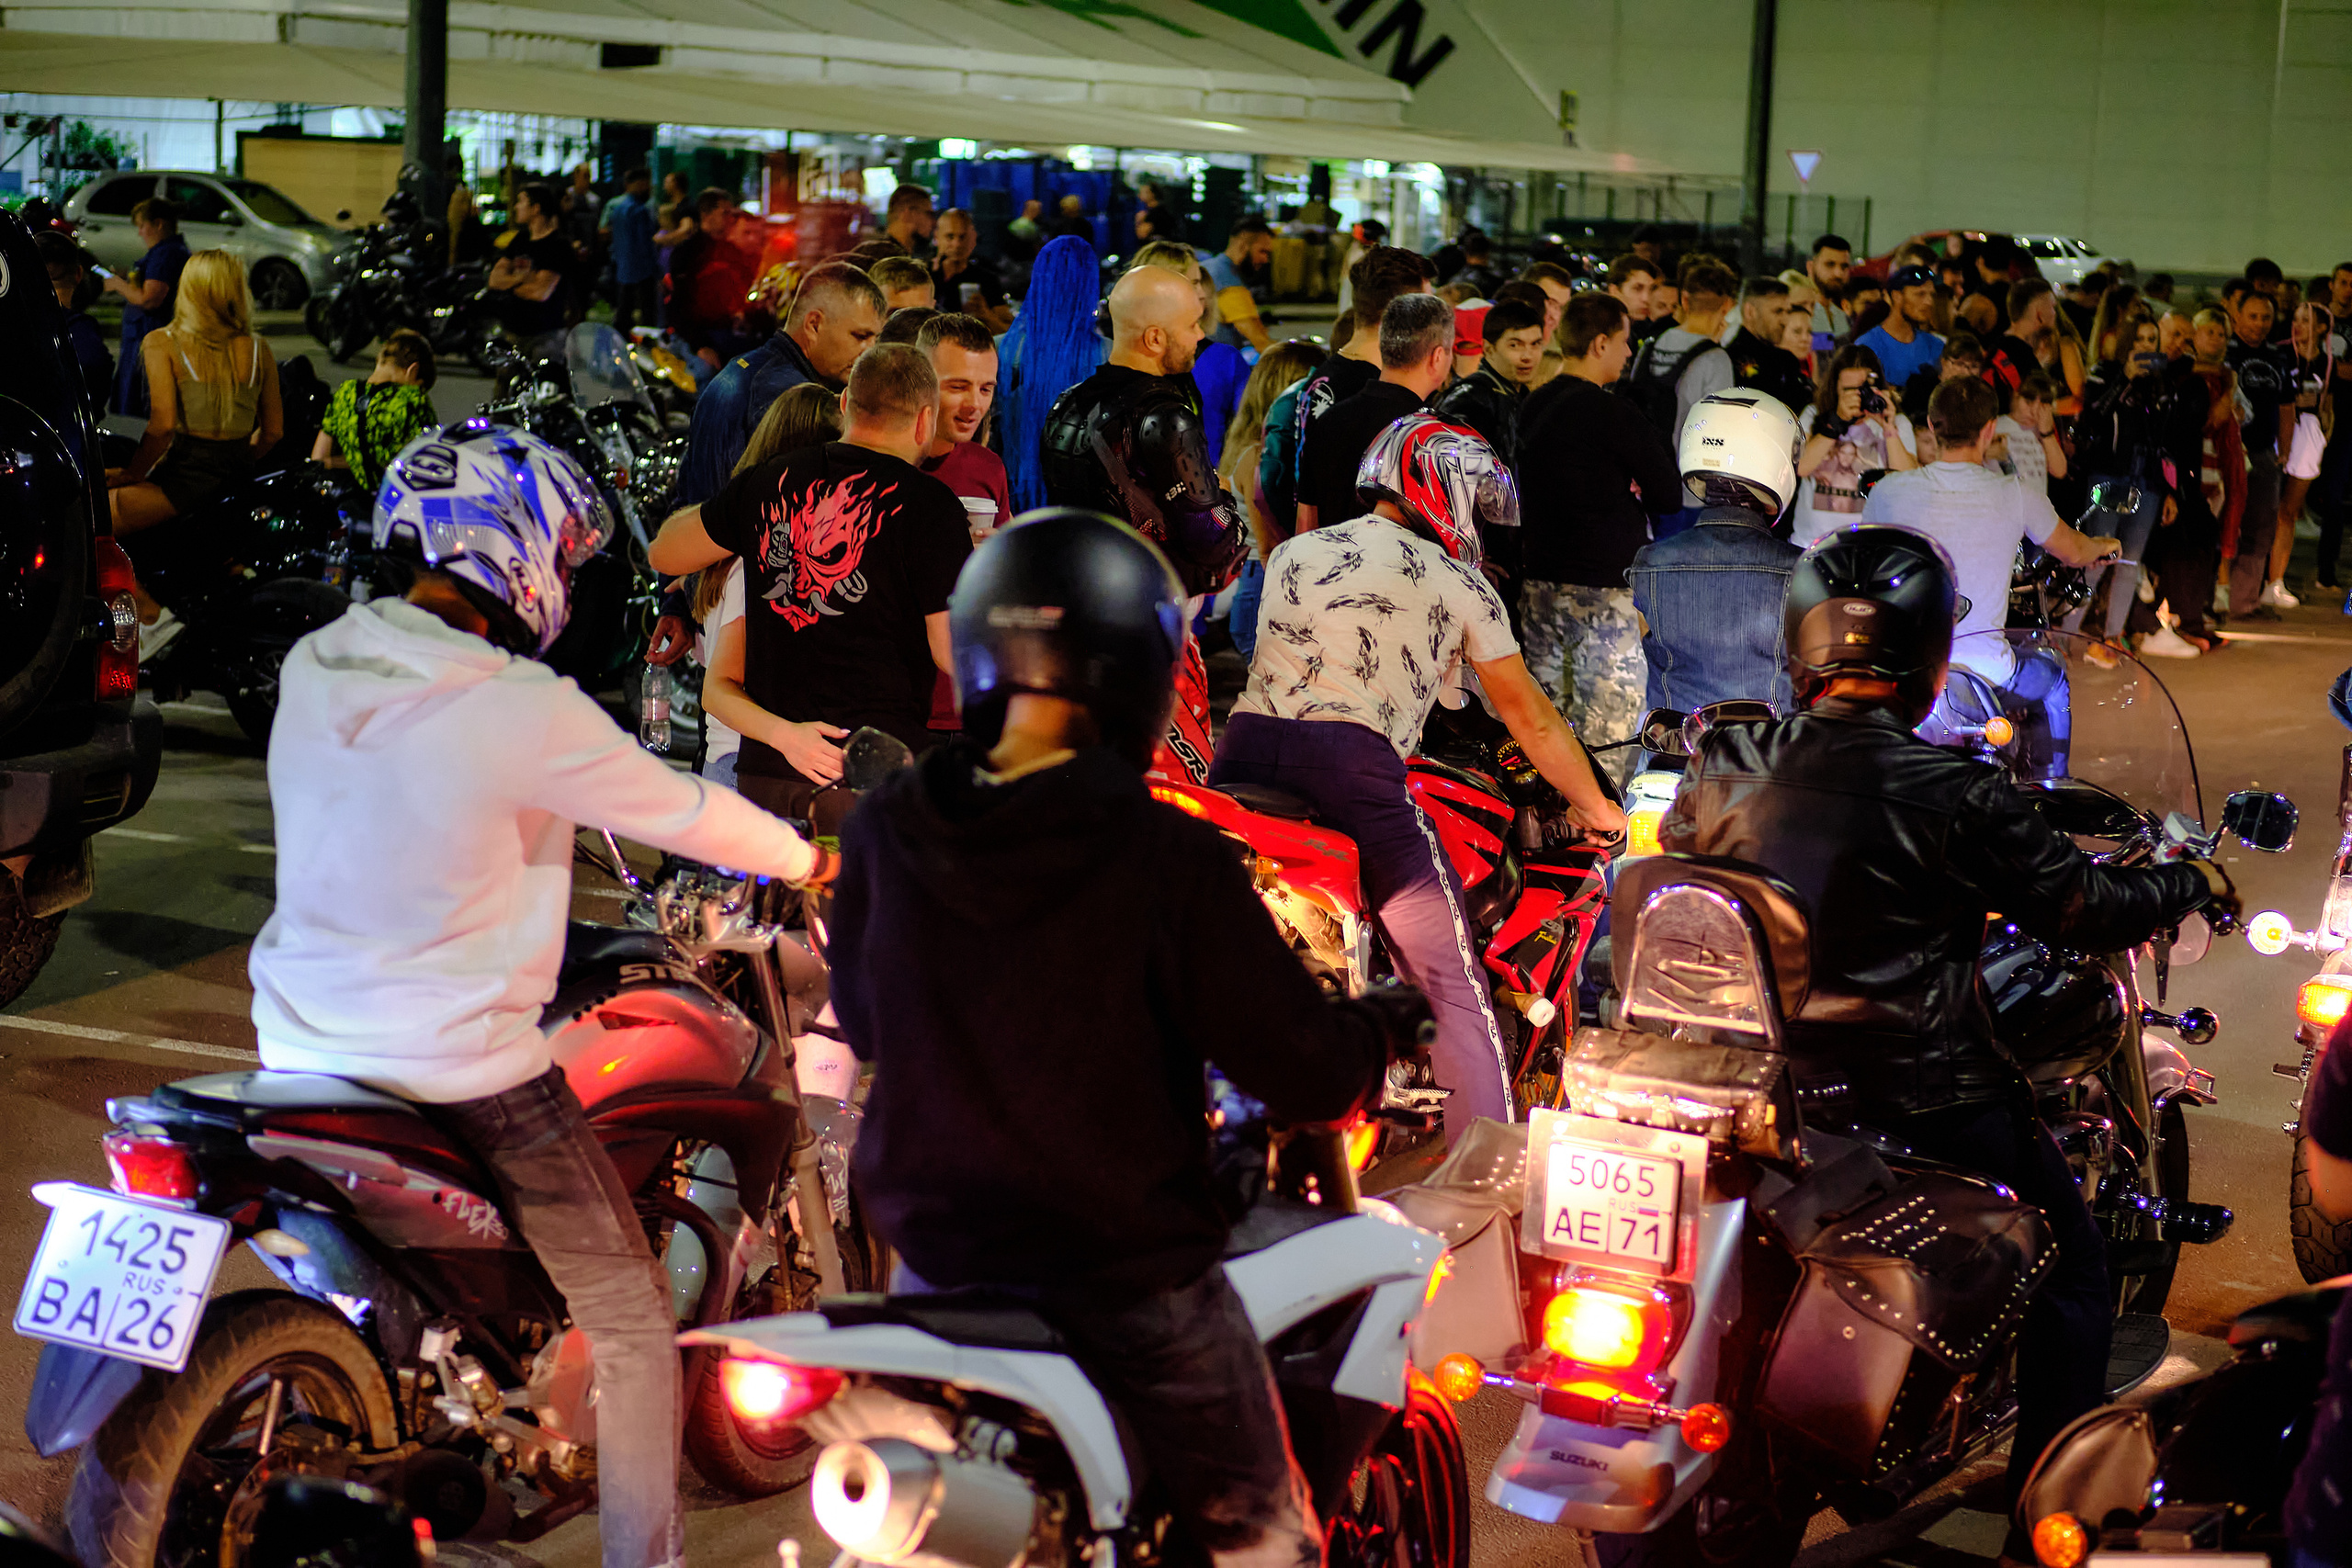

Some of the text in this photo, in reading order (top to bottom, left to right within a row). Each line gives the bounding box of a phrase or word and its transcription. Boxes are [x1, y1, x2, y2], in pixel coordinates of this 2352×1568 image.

[1568, 1154, 1656, 1198] 5065
[1609, 1197, 1636, 1213] RUS
[80, 1209, 195, 1274] 1425
[1552, 1206, 1660, 1256] AE 71
[122, 1271, 167, 1296] RUS
[30, 1275, 178, 1350] BA 26
[1550, 1450, 1609, 1472] SUZUKI
